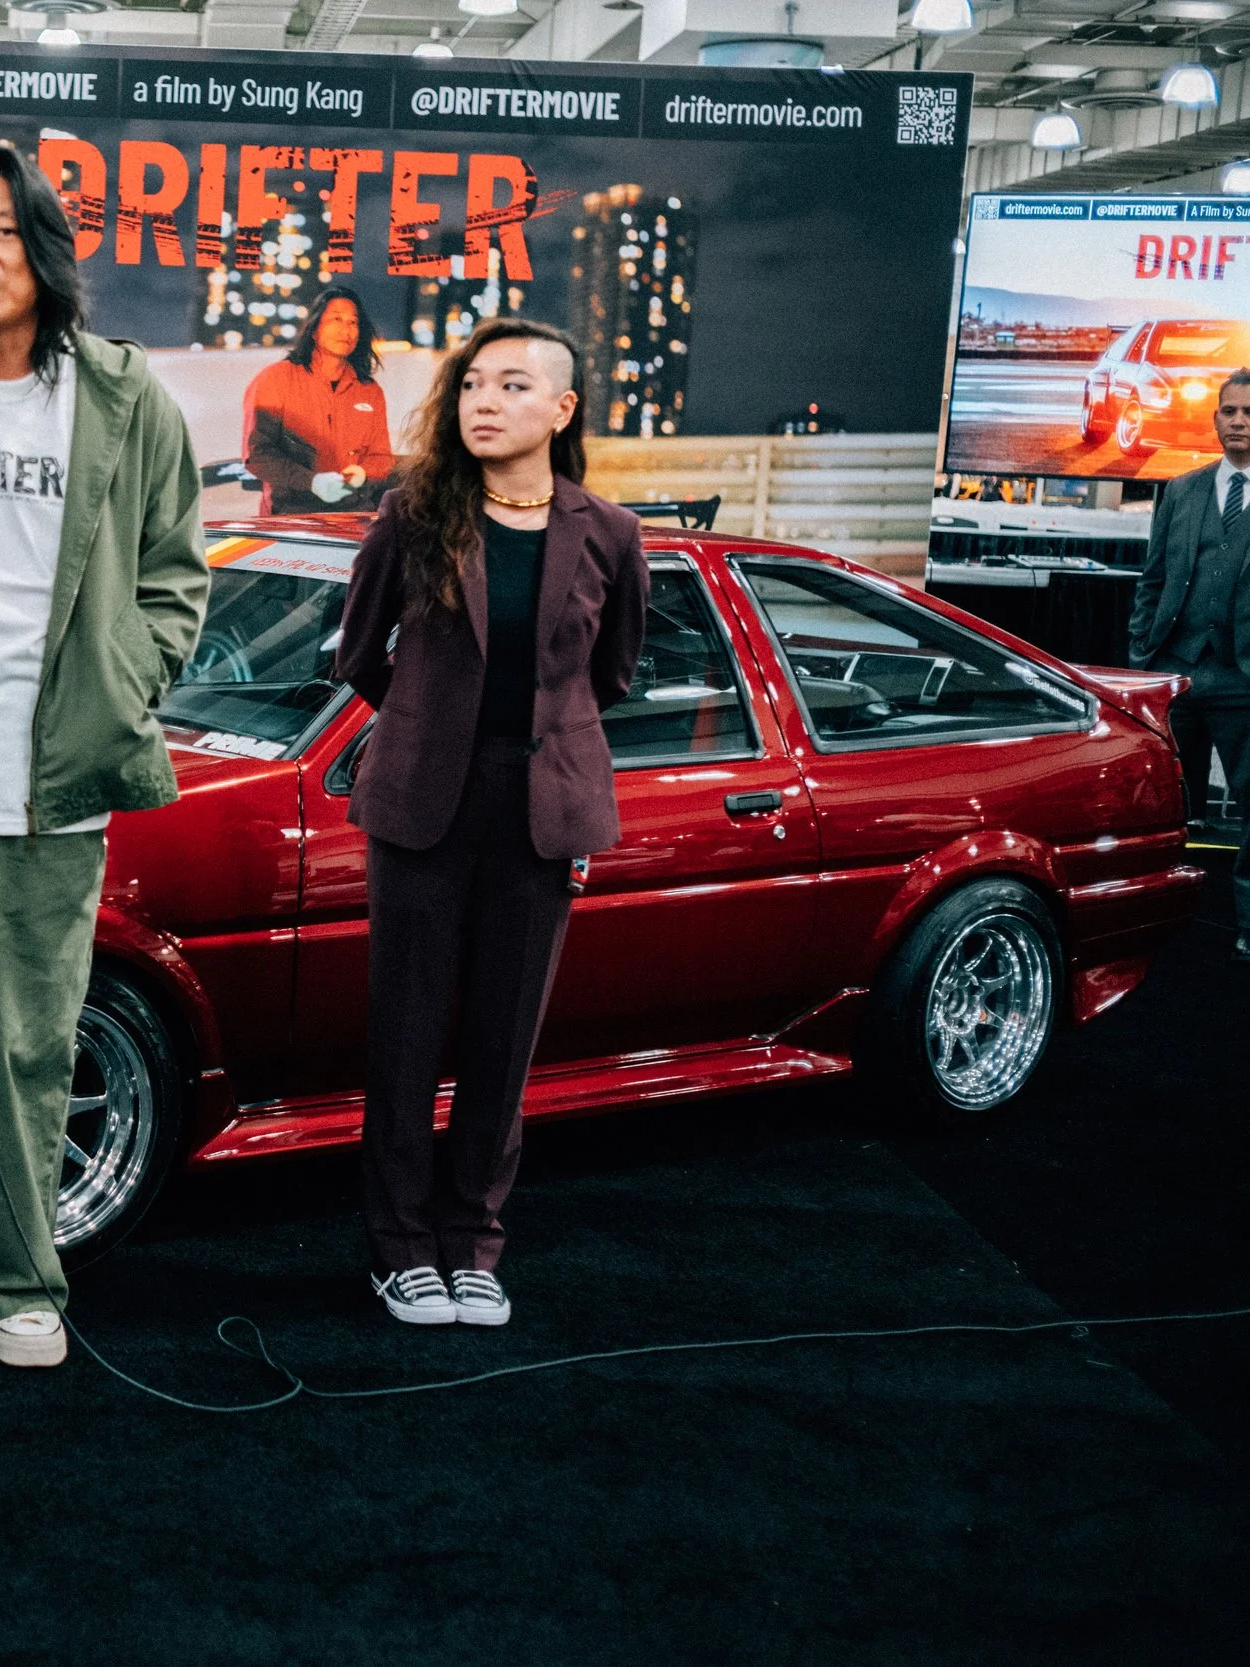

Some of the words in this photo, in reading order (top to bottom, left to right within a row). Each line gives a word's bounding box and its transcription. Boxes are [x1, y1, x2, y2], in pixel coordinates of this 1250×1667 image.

[132, 80, 148, 102] a
[154, 74, 201, 104] film
[207, 77, 236, 112] by
[241, 78, 299, 115] Sung
[305, 80, 364, 118] Kang
[410, 86, 621, 121] @DRIFTERMOVIE
[665, 94, 863, 128] driftermovie.com
[37, 138, 540, 281] DRIFTER
[1005, 203, 1083, 216] driftermovie.com
[1096, 203, 1178, 217] @DRIFTERMOVIE
[1191, 205, 1198, 217] A
[1200, 205, 1220, 217] Film
[1223, 205, 1234, 220] by
[1134, 234, 1250, 281] DRIF
[192, 730, 289, 761] PRIME
